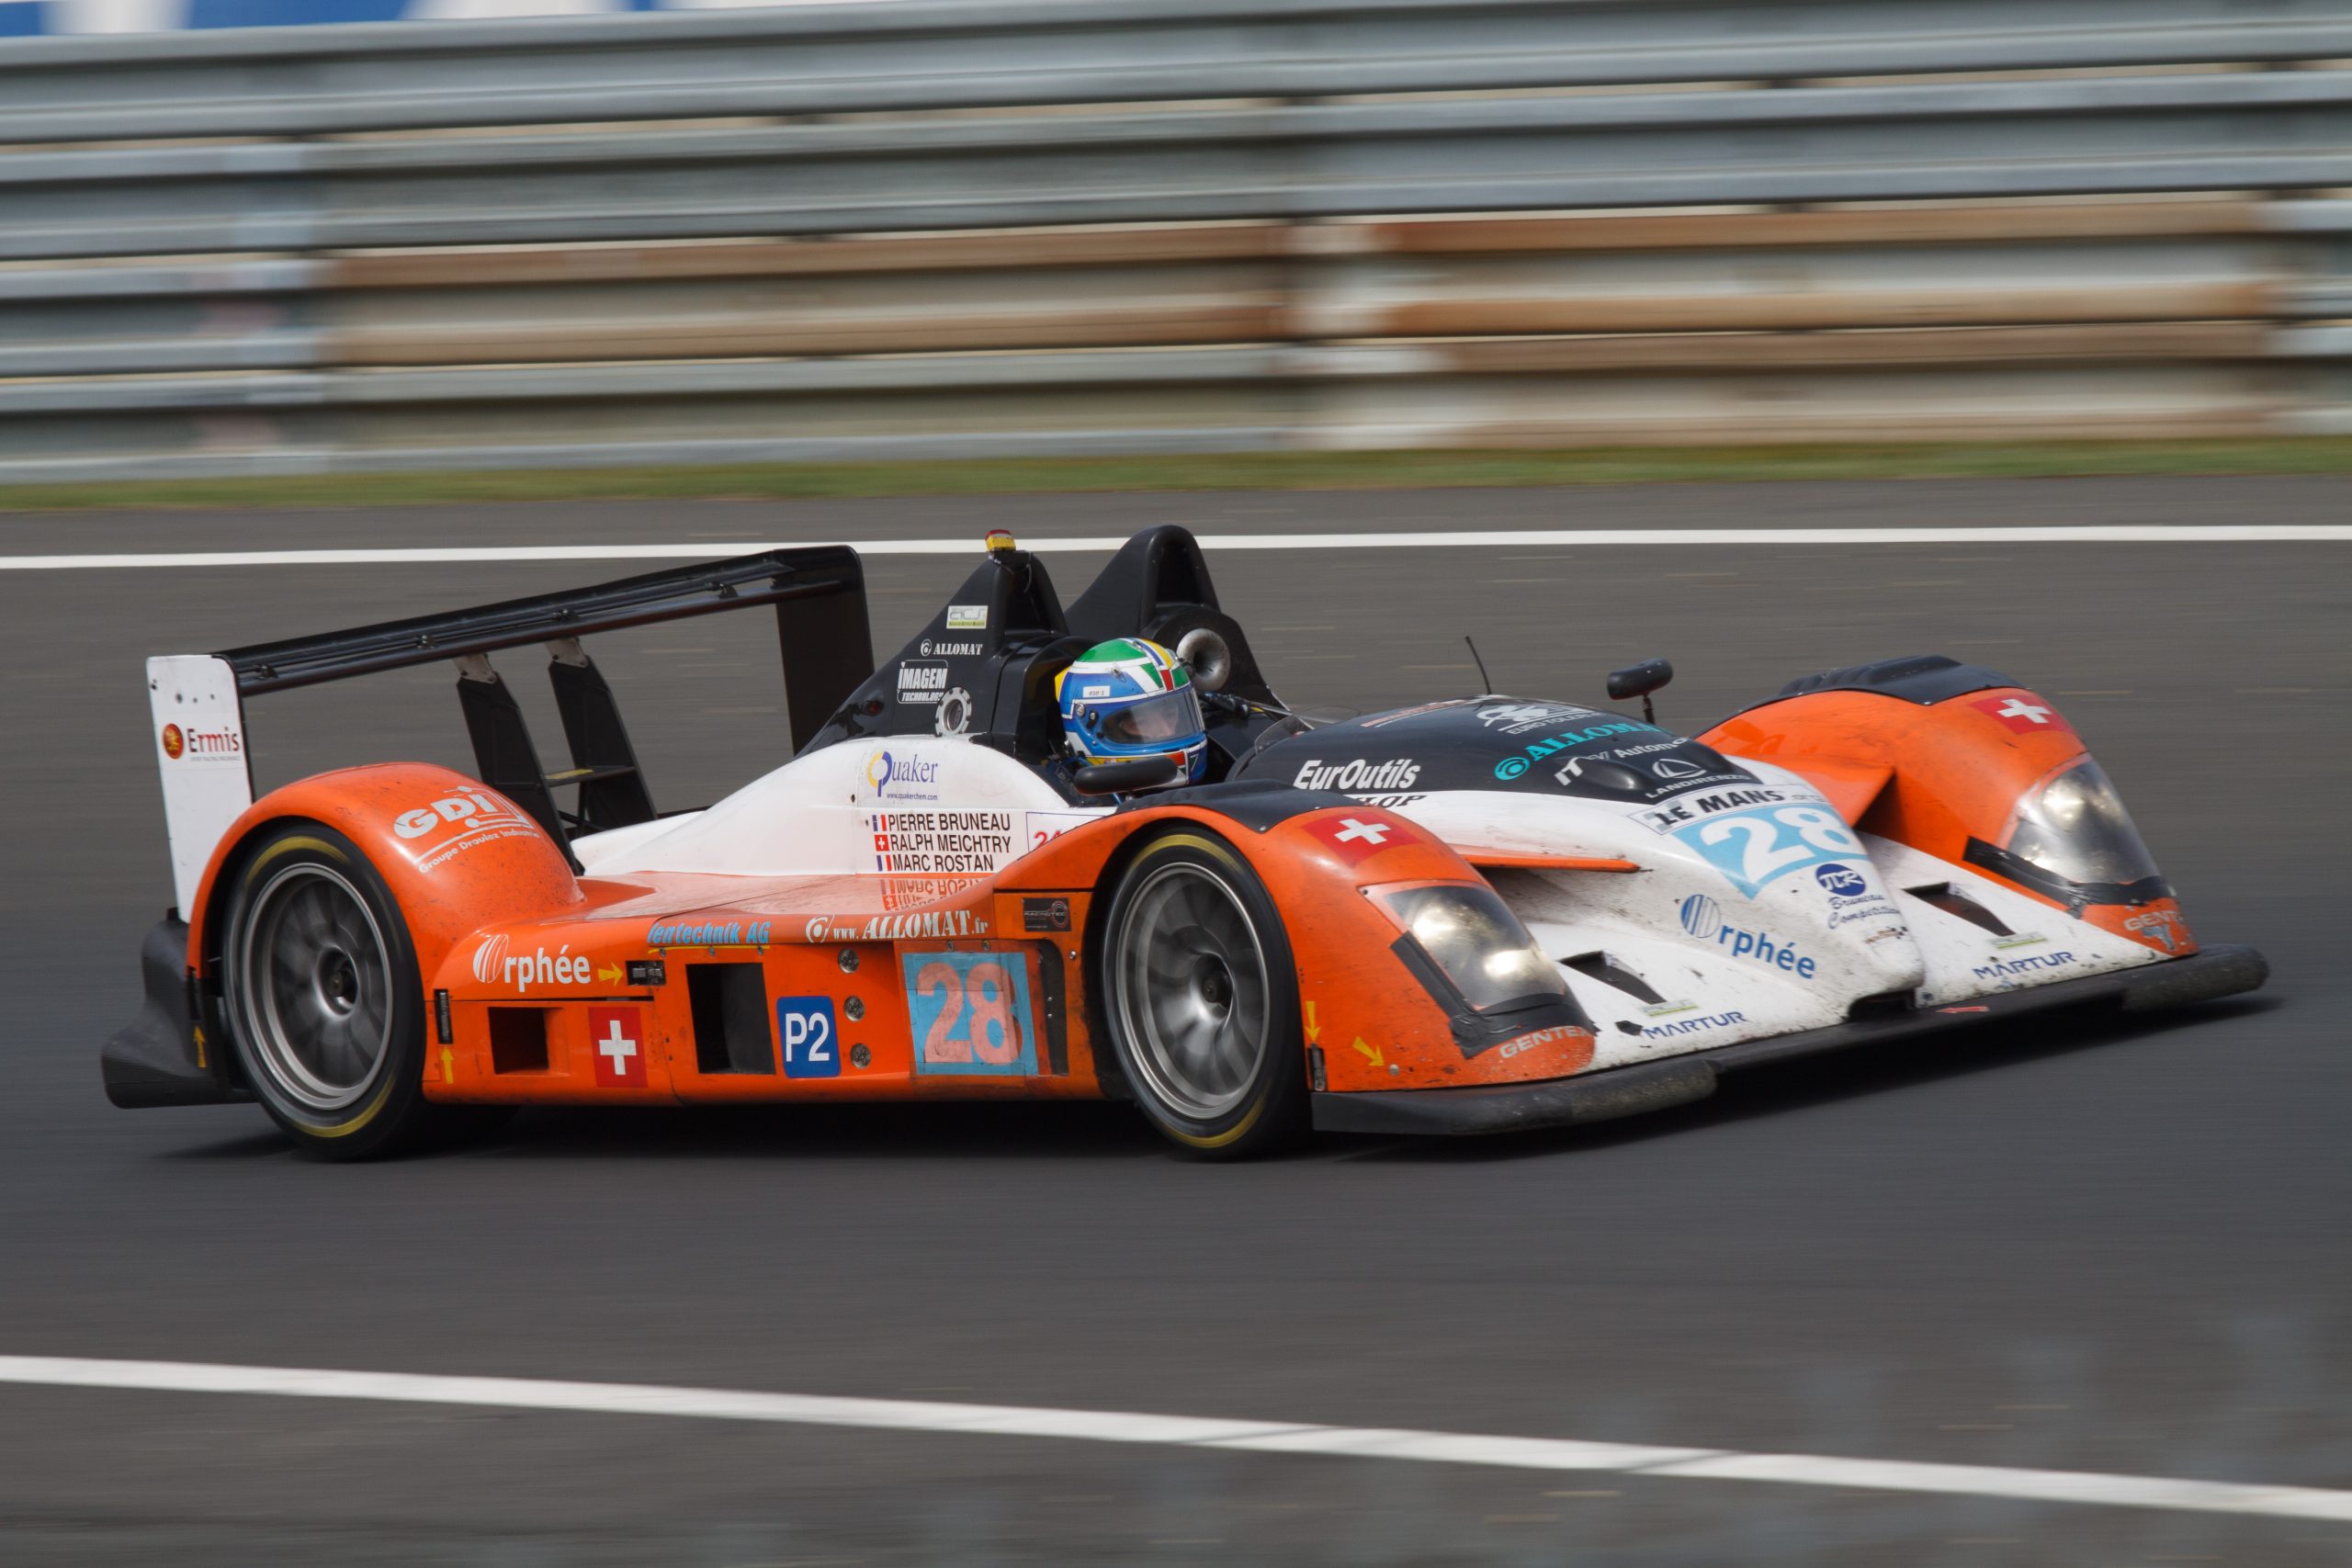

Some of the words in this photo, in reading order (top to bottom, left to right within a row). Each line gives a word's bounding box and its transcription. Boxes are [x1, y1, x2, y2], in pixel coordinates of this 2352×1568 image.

[933, 643, 983, 656] ALLOMAT
[187, 726, 240, 752] Ermis
[867, 750, 939, 797] Quaker
[1293, 759, 1421, 790] EurOutils
[887, 793, 938, 801] www.quakerchem.com
[1655, 806, 1696, 826] LE
[1696, 790, 1785, 814] MANS
[393, 795, 498, 840] GDI
[888, 814, 935, 832] PIERRE
[939, 813, 1011, 831] BRUNEAU
[418, 846, 458, 874] Groupe
[458, 831, 500, 851] Droulez
[890, 834, 933, 852] RALPH
[937, 834, 1011, 852] MEICHTRY
[1700, 807, 1869, 883] 28
[893, 854, 931, 872] MARC
[934, 854, 994, 872] ROSTAN
[745, 921, 771, 944] AG
[1973, 952, 2077, 980] MARTUR
[917, 962, 1023, 1065] 28
[1642, 1011, 1750, 1040] MARTUR
[786, 1012, 831, 1062] P2
